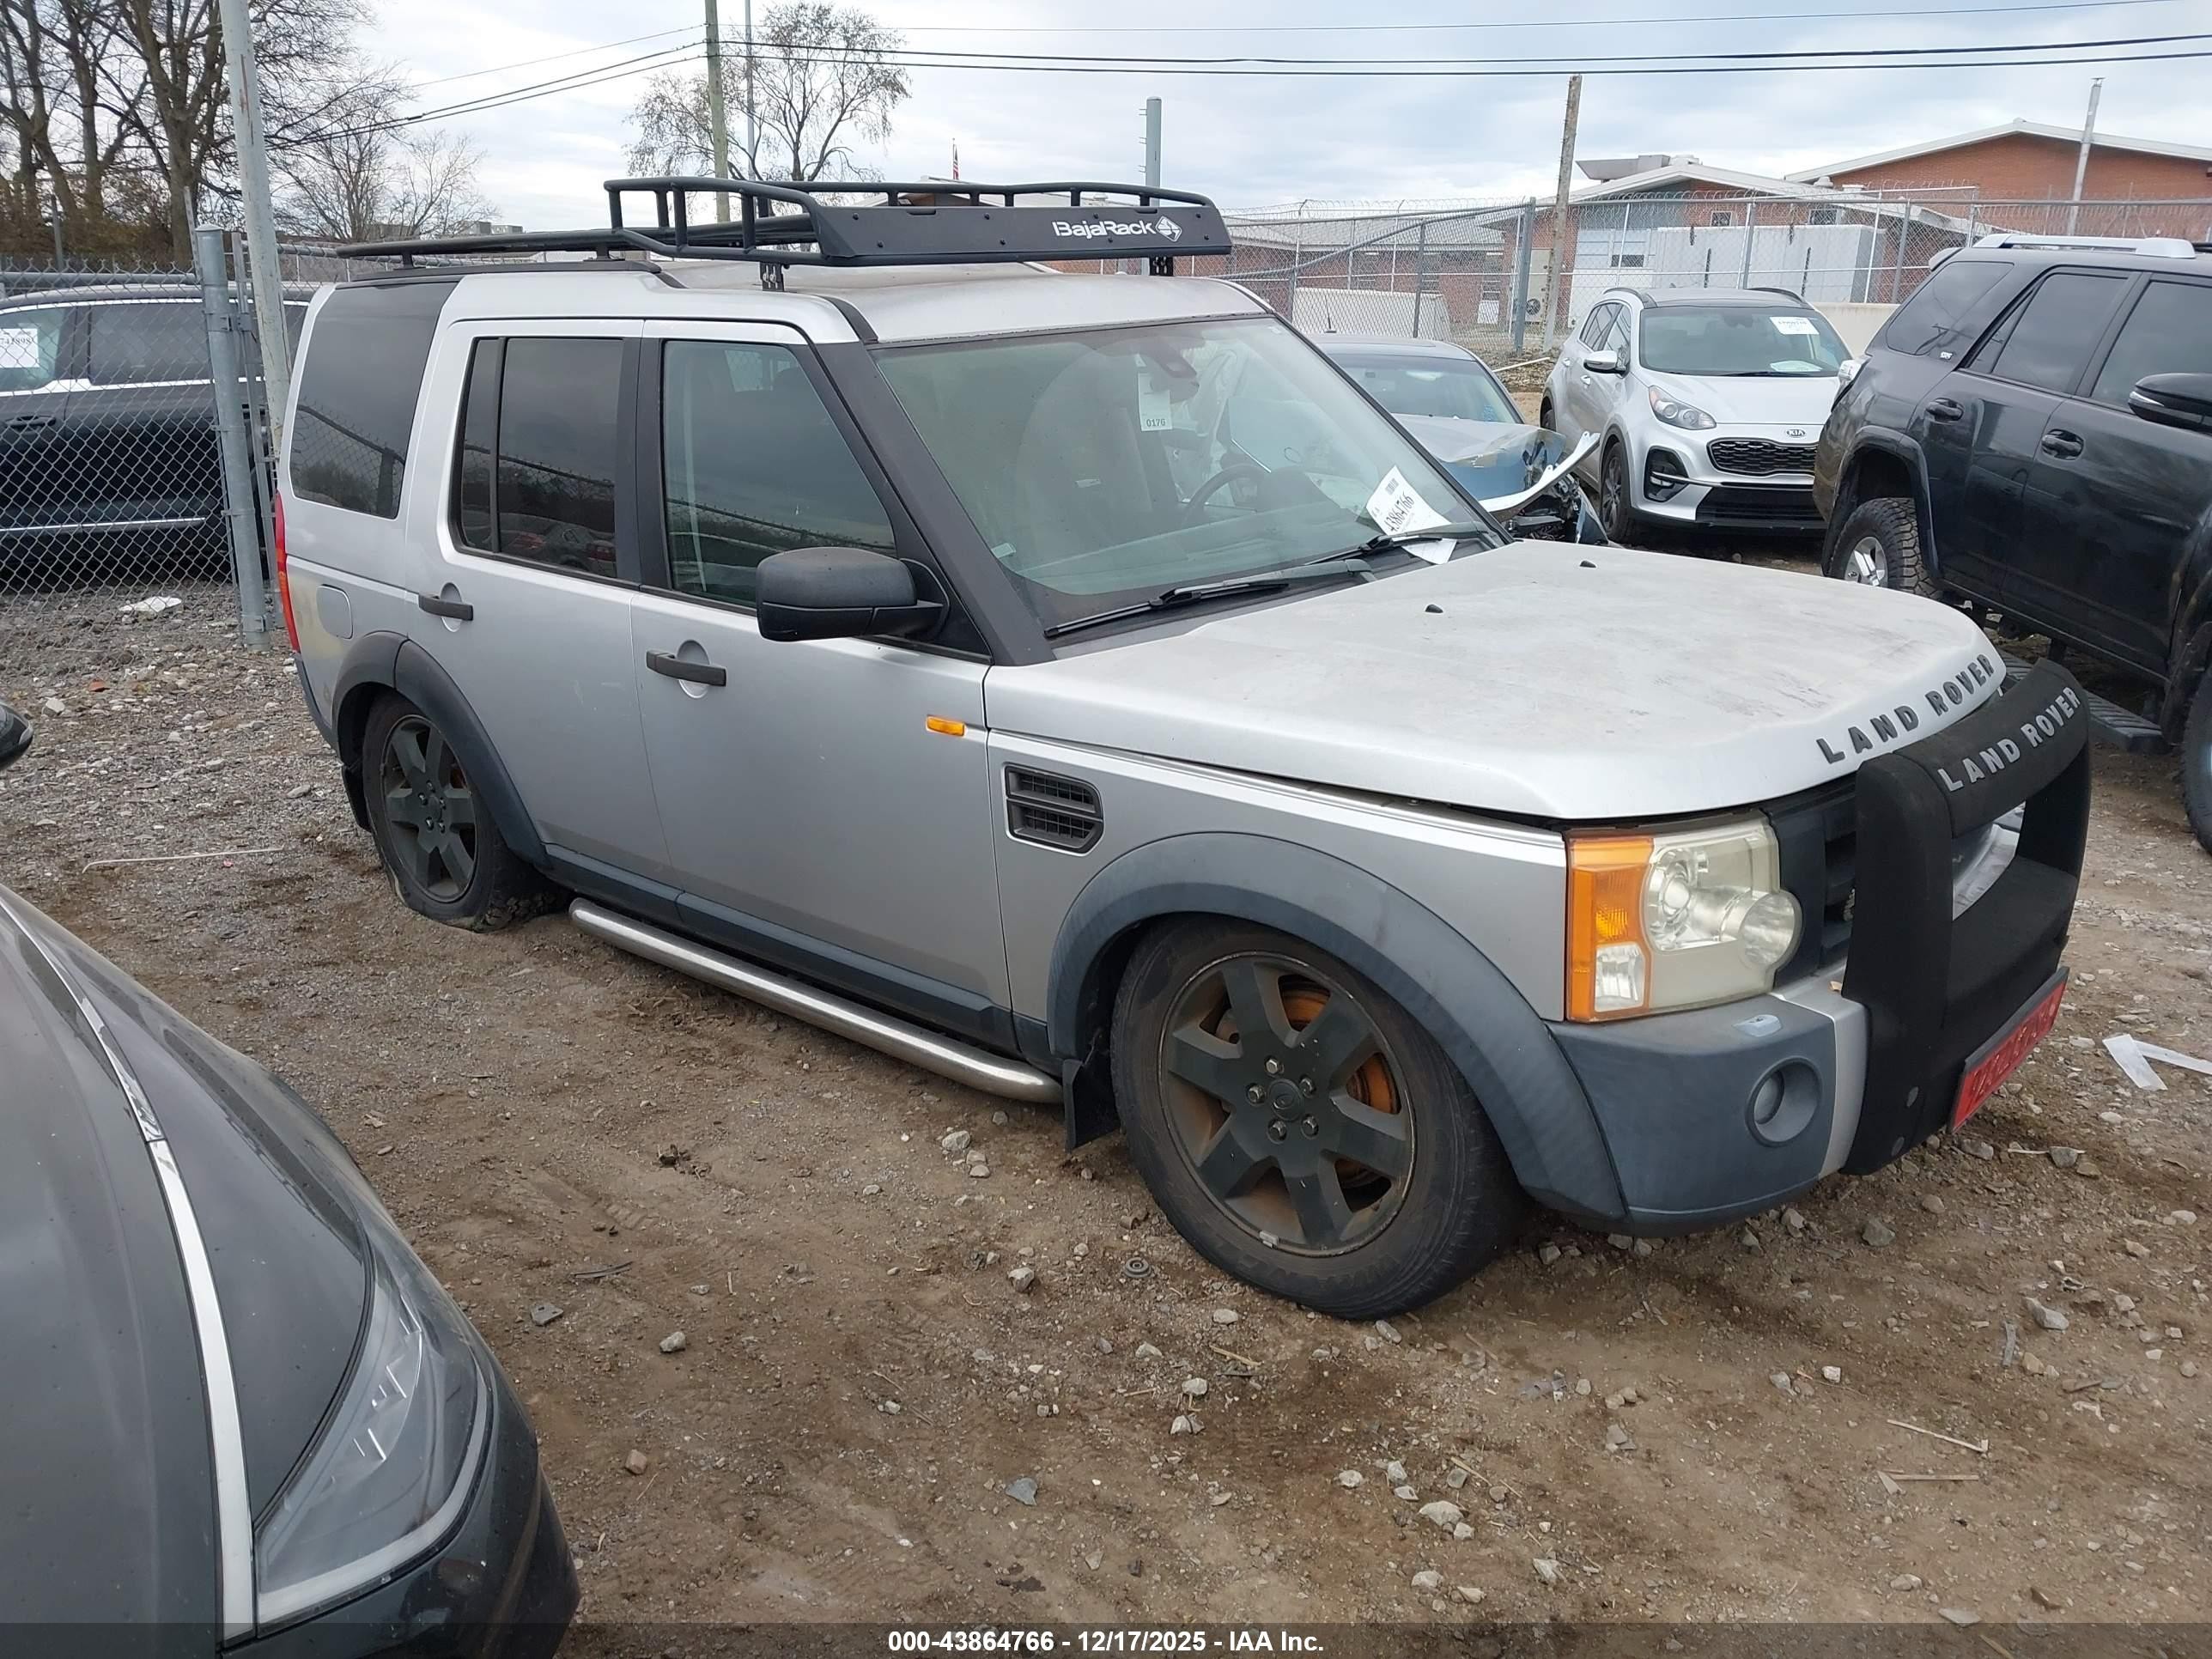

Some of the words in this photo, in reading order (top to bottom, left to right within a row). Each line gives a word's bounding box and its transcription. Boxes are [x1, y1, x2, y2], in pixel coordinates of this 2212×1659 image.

[1052, 220, 1156, 240] BajaRack
[1383, 492, 1415, 532] 43864766
[1816, 705, 1919, 764] LAND
[1924, 653, 1995, 716] ROVER
[1937, 738, 2021, 792] LAND
[2021, 686, 2081, 748] ROVER
